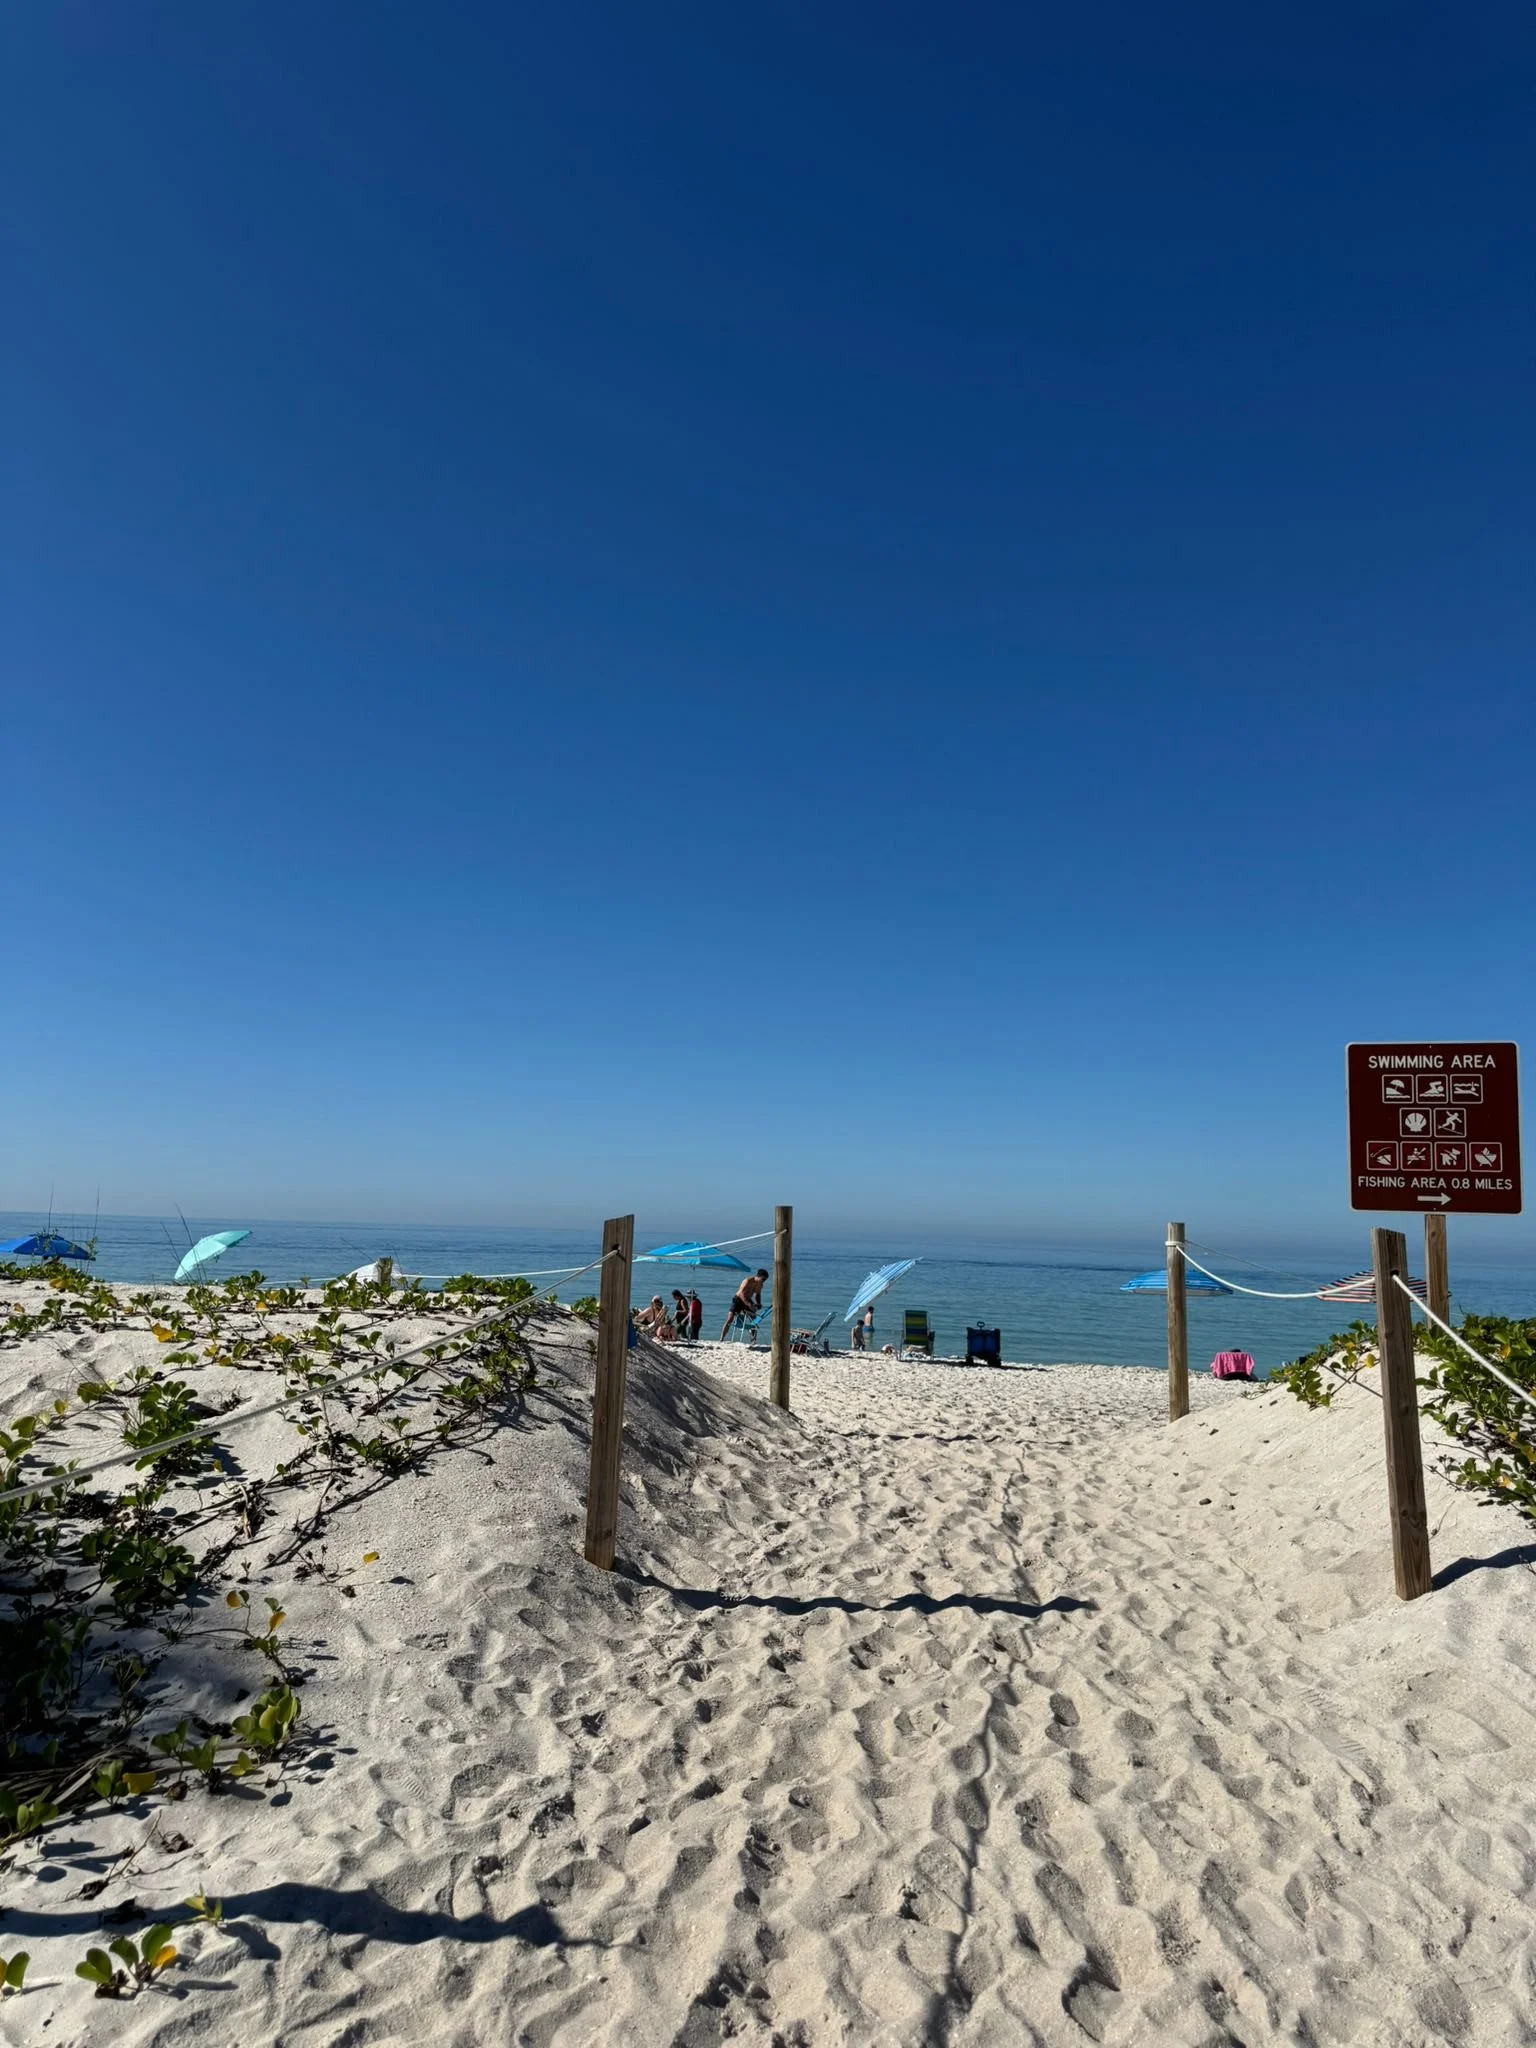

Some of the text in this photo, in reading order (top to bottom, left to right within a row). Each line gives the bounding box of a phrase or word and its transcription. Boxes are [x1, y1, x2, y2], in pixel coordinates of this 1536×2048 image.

[1368, 1054, 1496, 1068] SWIMMING AREA
[1358, 1176, 1512, 1190] FISHING AREA 0.8 MILES
